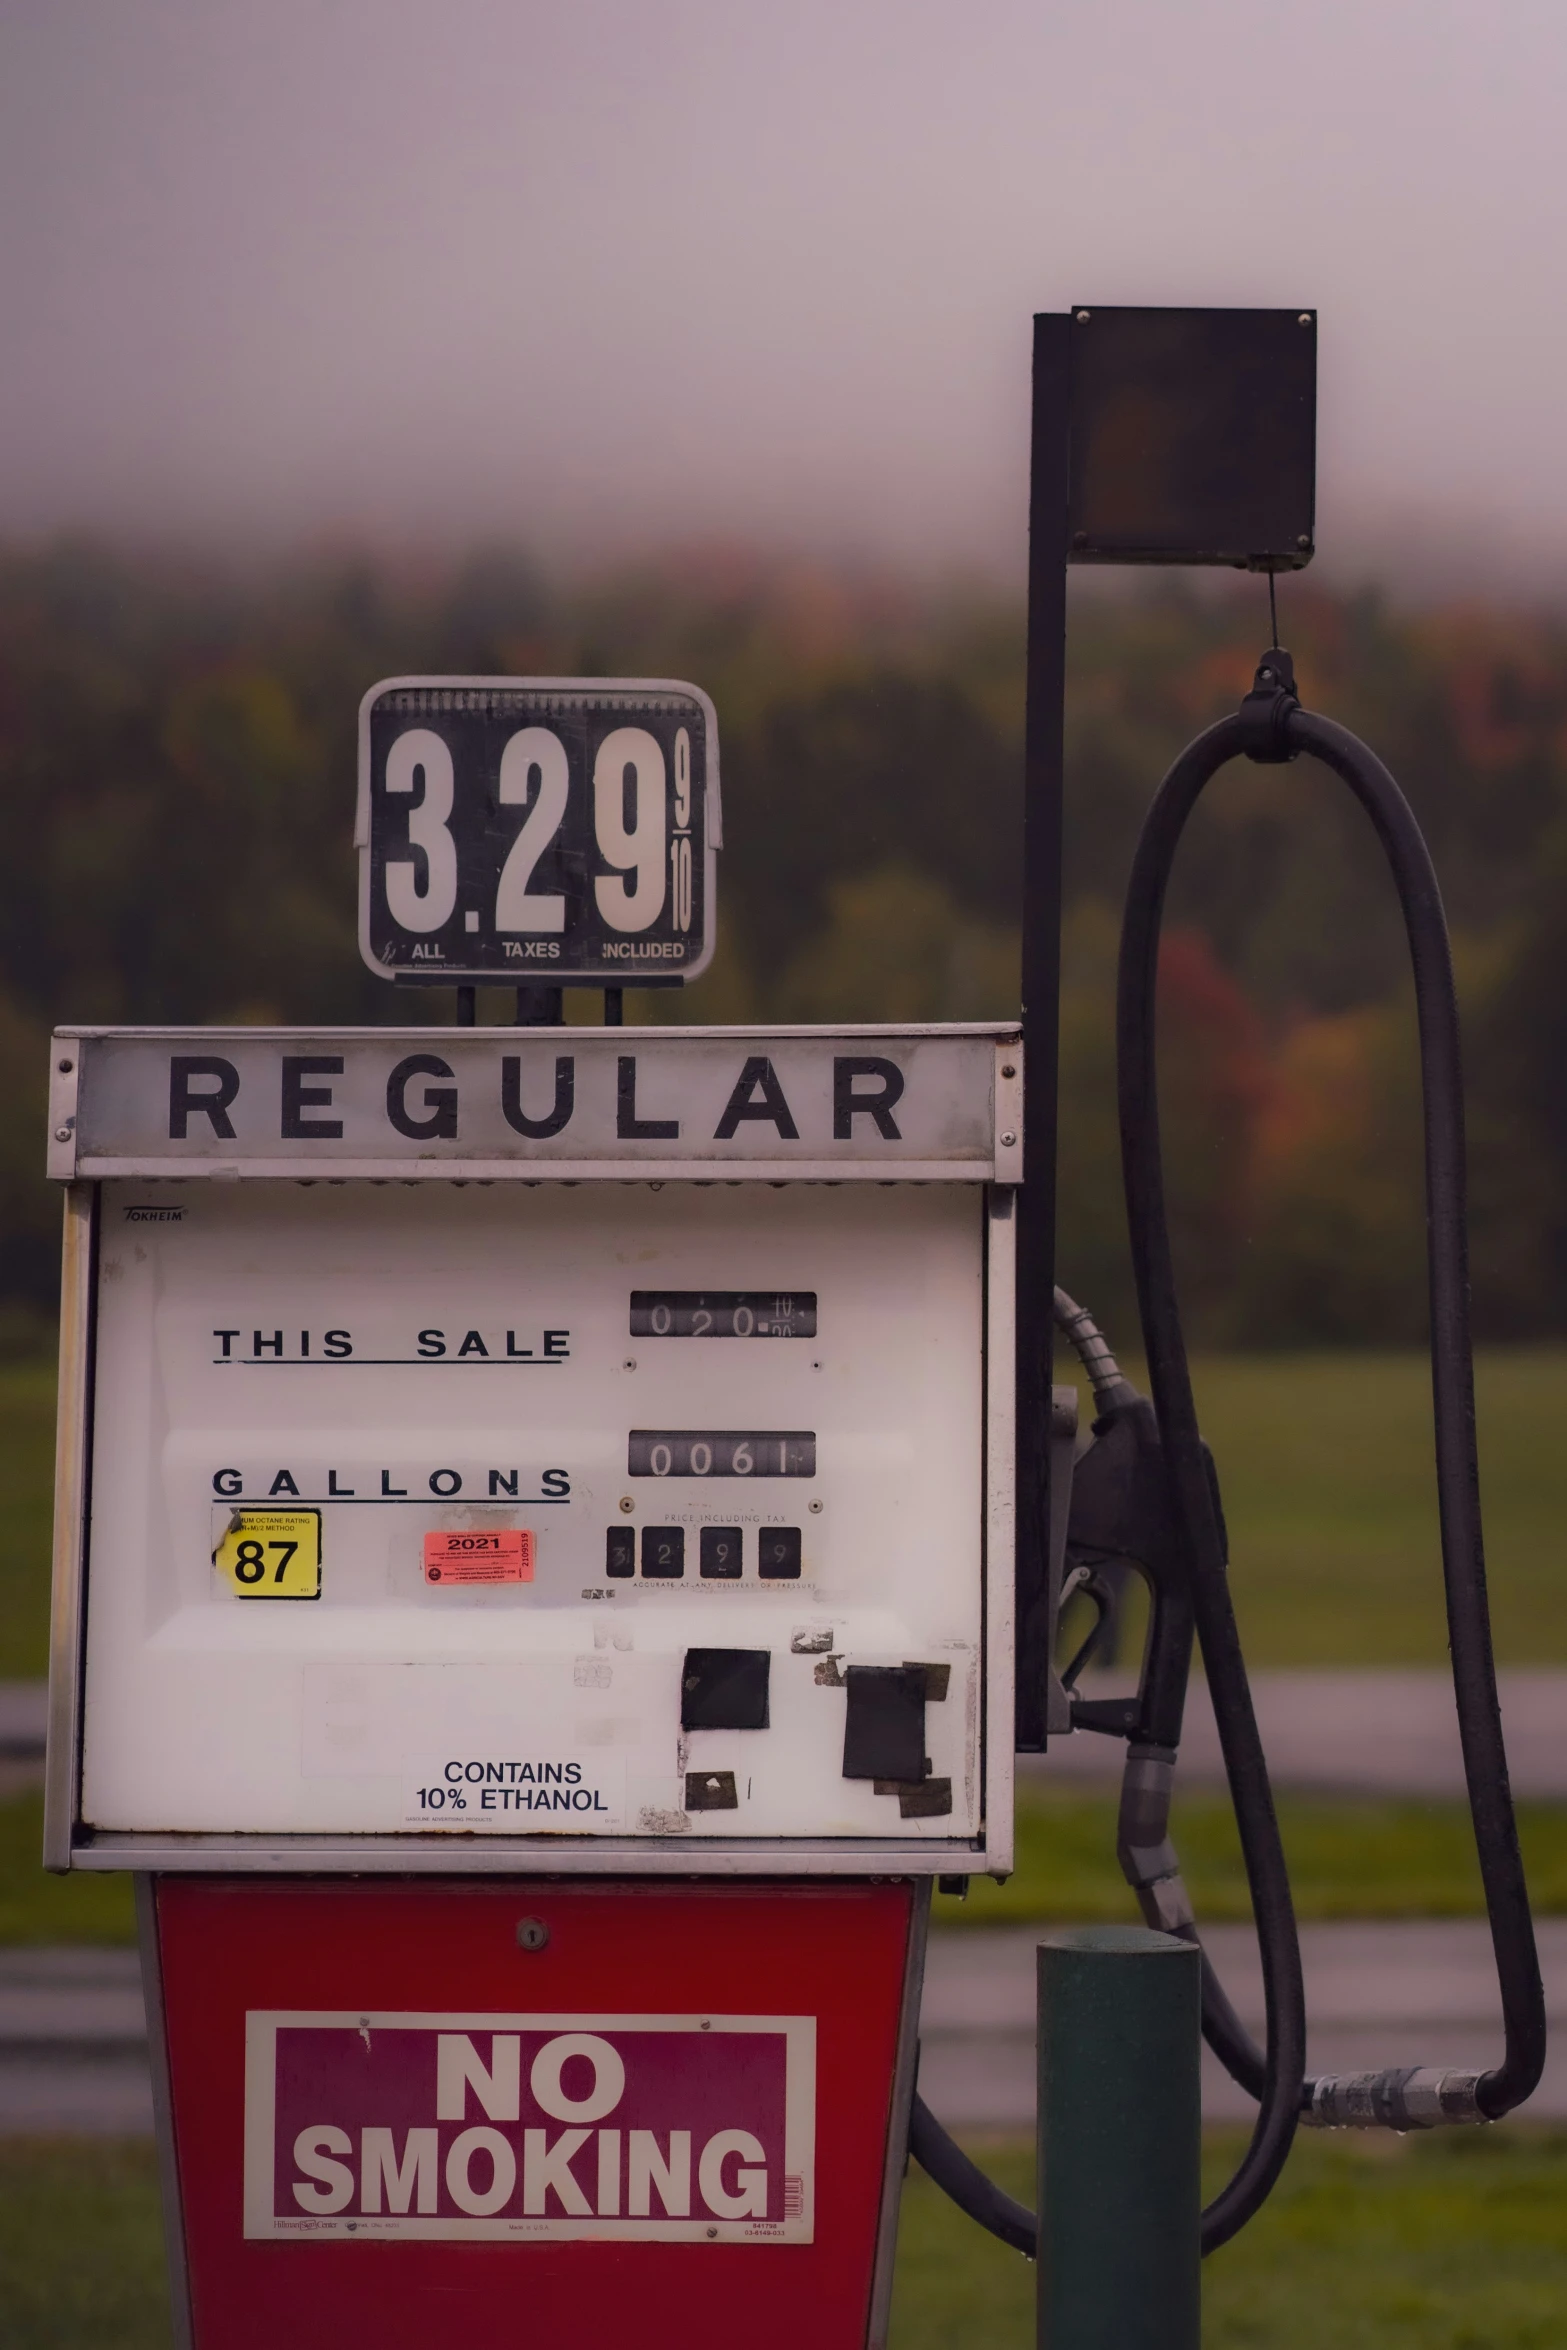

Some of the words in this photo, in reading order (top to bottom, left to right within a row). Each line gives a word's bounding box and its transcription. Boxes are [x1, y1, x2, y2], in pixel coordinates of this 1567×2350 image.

[385, 727, 666, 933] 3.29
[411, 943, 446, 959] ALL
[502, 941, 561, 958] TAXES
[603, 943, 685, 959] INCLUDED
[168, 1054, 906, 1141] REGULAR
[123, 1205, 184, 1221] TOKHEIM
[213, 1330, 354, 1357] THIS
[417, 1330, 571, 1357] SALE
[212, 1468, 571, 1497] GALLONS
[664, 1514, 694, 1522] PRICE
[700, 1514, 760, 1522] INCLUDING
[447, 1538, 500, 1550] 2021
[521, 1533, 529, 1567] 2109519
[658, 1544, 671, 1564] 2
[716, 1544, 729, 1563] 9
[773, 1545, 786, 1563] 9
[235, 1540, 298, 1584] 87
[444, 1761, 582, 1784] CONTAINS
[416, 1788, 467, 1810] 10%
[481, 1789, 608, 1811] ETHANOL
[436, 2033, 626, 2123] NO
[292, 2124, 768, 2219] SMOKING
[273, 2221, 300, 2229] Hillman
[317, 2221, 338, 2229] Center
